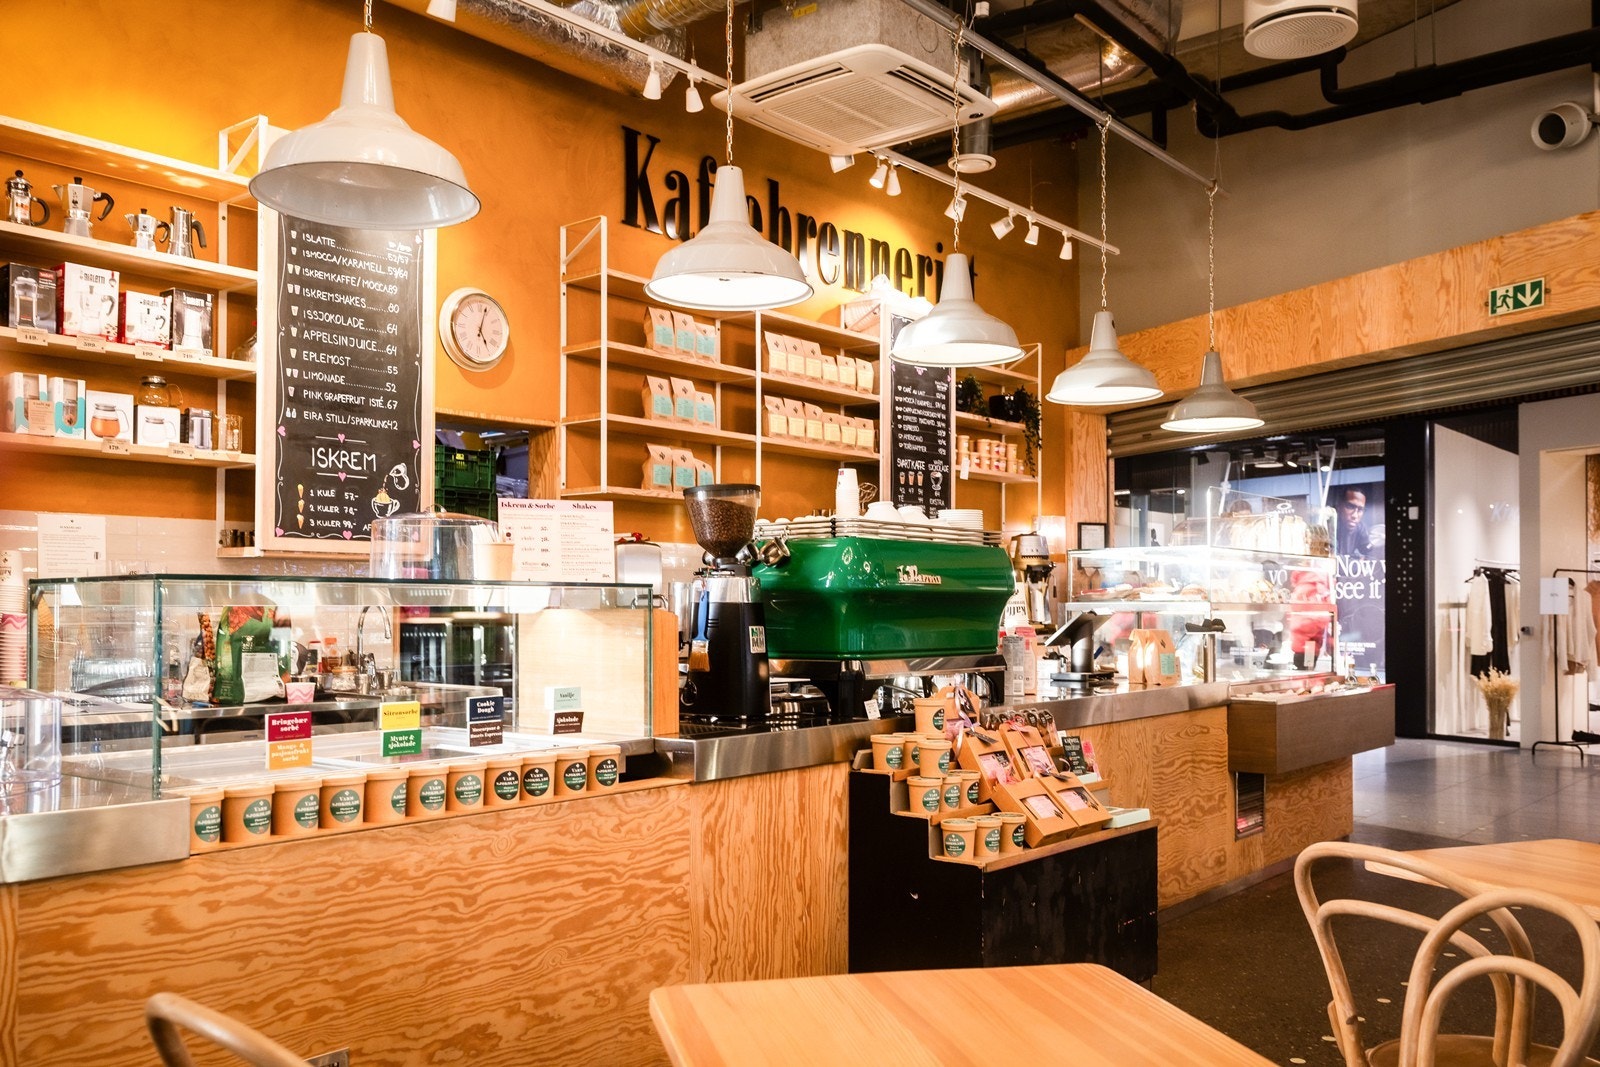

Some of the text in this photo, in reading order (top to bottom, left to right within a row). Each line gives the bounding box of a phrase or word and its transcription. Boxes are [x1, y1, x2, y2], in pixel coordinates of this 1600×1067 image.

[621, 125, 978, 302] Kafbrennerit
[302, 233, 336, 248] ISLATTE
[302, 287, 400, 314] ISKREMSHAKES 80
[303, 309, 398, 336] ISSJOKOLADE 64
[386, 344, 398, 357] 64
[302, 350, 399, 375] EPLEMOST 55
[303, 371, 397, 393] LIMONADE 52
[303, 389, 323, 400] PINK
[324, 390, 366, 405] GRAPEFRUIT
[387, 400, 399, 410] 67
[303, 412, 324, 422] EIRA
[311, 447, 377, 472] ISKREM
[317, 489, 336, 498] KULE
[317, 504, 340, 514] KULER
[309, 518, 315, 527] 3
[316, 518, 341, 528] KULER
[1335, 554, 1376, 578] Now
[1335, 579, 1365, 600] see
[476, 700, 496, 708] Cookie
[477, 706, 495, 714] Dough
[388, 740, 417, 750] sjokolade
